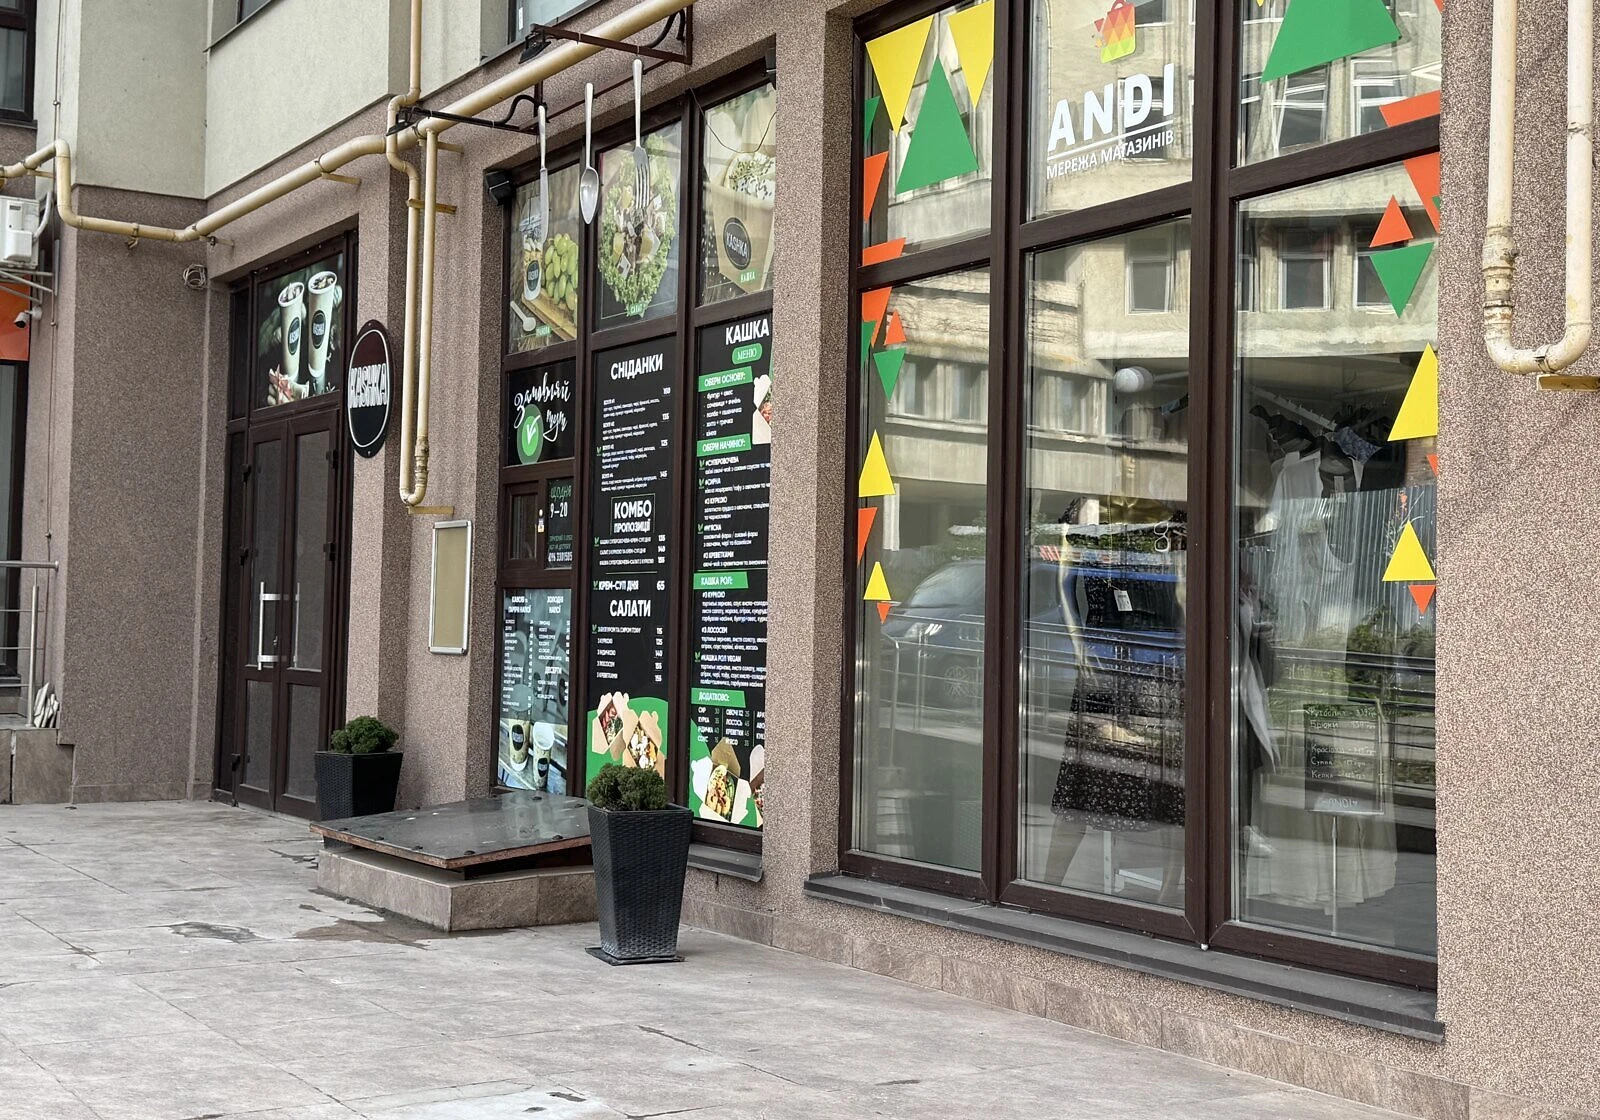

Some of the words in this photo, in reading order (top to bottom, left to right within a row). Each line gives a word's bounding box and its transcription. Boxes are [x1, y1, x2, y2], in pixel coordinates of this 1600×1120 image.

[1047, 63, 1174, 153] ANDI
[1046, 152, 1098, 180] МЕРЕЖА
[1101, 130, 1174, 164] МАГАЗИНІВ
[725, 318, 770, 346] КАШКА
[737, 348, 757, 361] МЕНЮ
[610, 353, 664, 381] СНІДАНКИ
[349, 363, 387, 409] KASHKA
[704, 376, 721, 388] ОБЕРИ
[613, 500, 652, 520] КОМБО
[613, 518, 651, 534] ПРОПОЗИЦІЇ
[657, 580, 666, 591] 65
[701, 577, 720, 586] КАШКА
[610, 600, 652, 618] САЛАТИ
